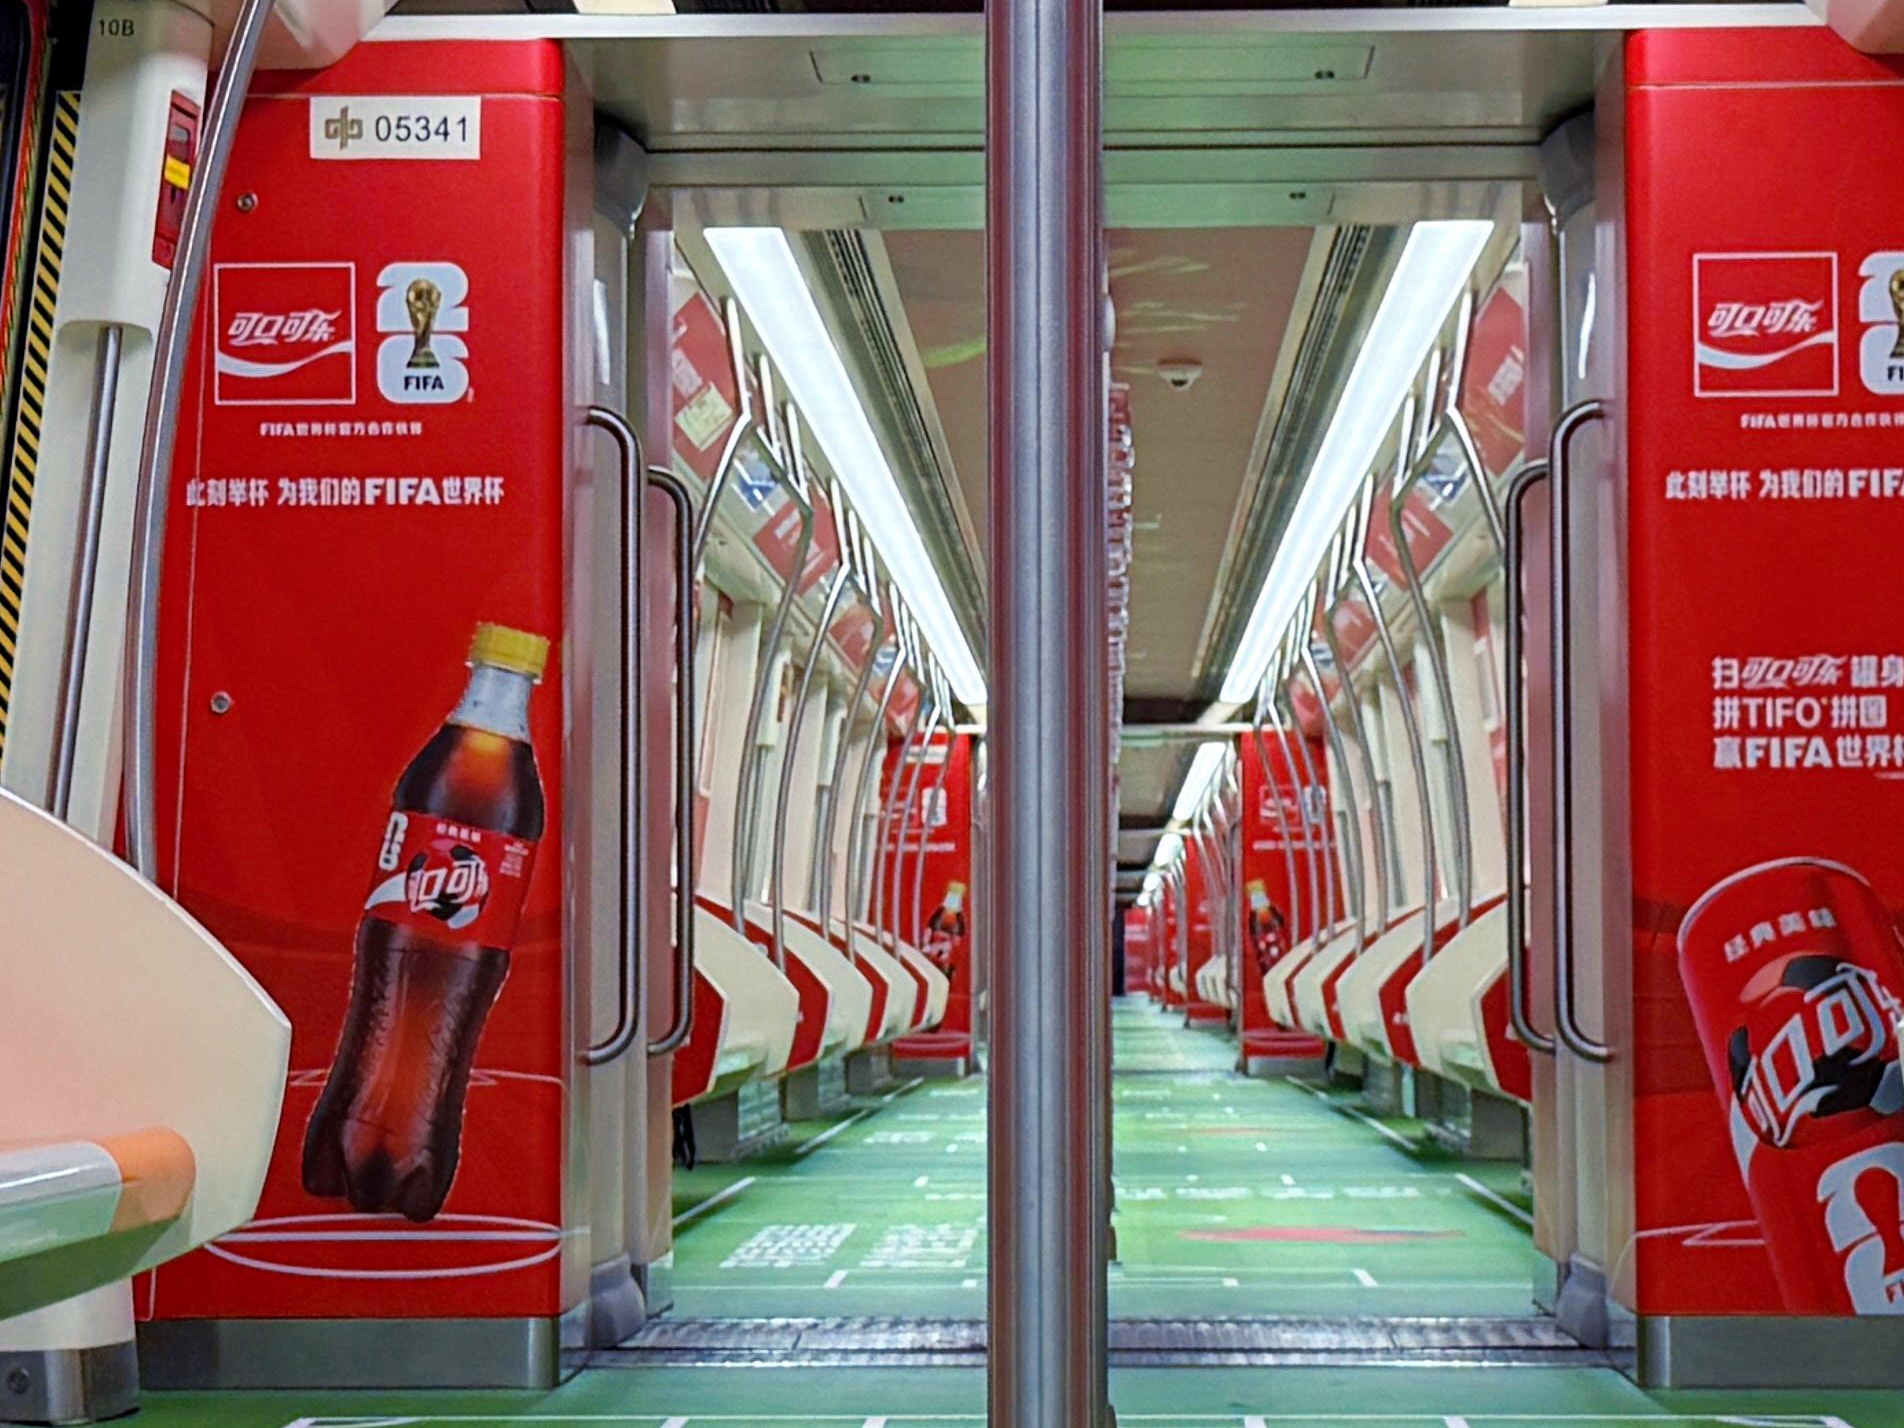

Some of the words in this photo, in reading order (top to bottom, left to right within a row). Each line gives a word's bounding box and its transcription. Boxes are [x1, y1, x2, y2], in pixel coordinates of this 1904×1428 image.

[98, 19, 135, 37] 10B
[374, 114, 469, 144] 05341
[227, 308, 343, 347] 可口可乐
[1707, 298, 1825, 337] 可口可乐
[403, 374, 444, 392] FIFA
[186, 477, 269, 507] 此刻举杯
[278, 476, 505, 507] 为我们的FIFA世界杯
[1665, 470, 1751, 501] 此刻举杯
